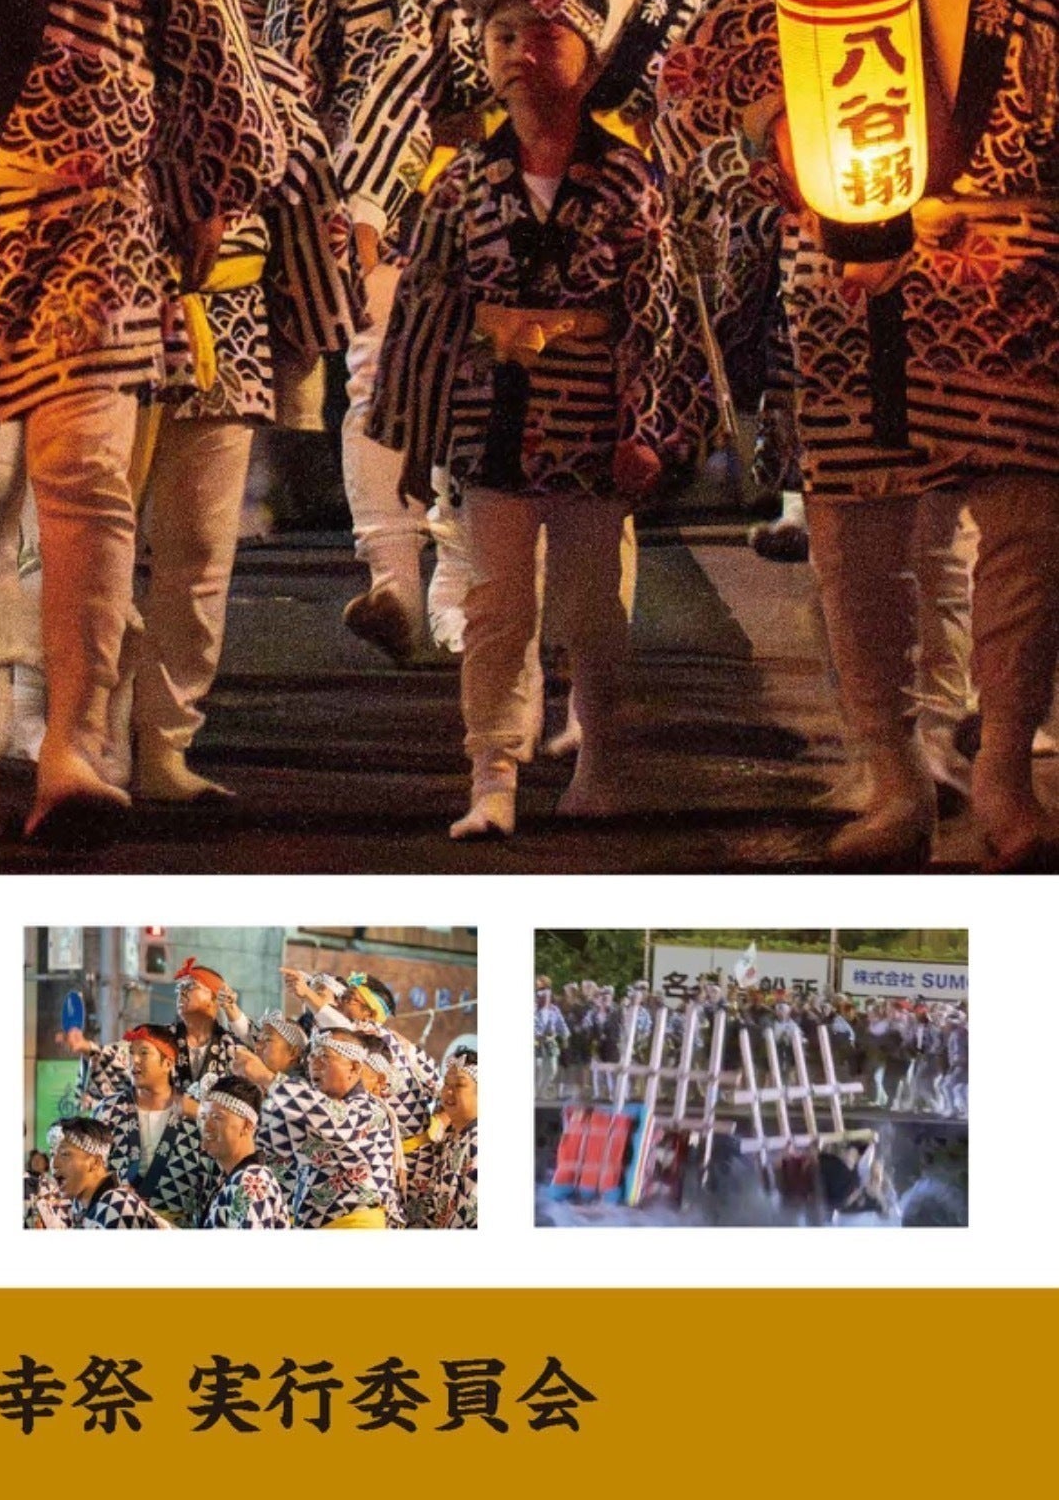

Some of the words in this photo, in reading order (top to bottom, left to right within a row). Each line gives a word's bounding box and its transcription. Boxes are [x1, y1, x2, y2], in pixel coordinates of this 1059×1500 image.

[832, 25, 913, 206] 八谷搦
[853, 969, 915, 988] 株式会社
[922, 972, 968, 990] SUM
